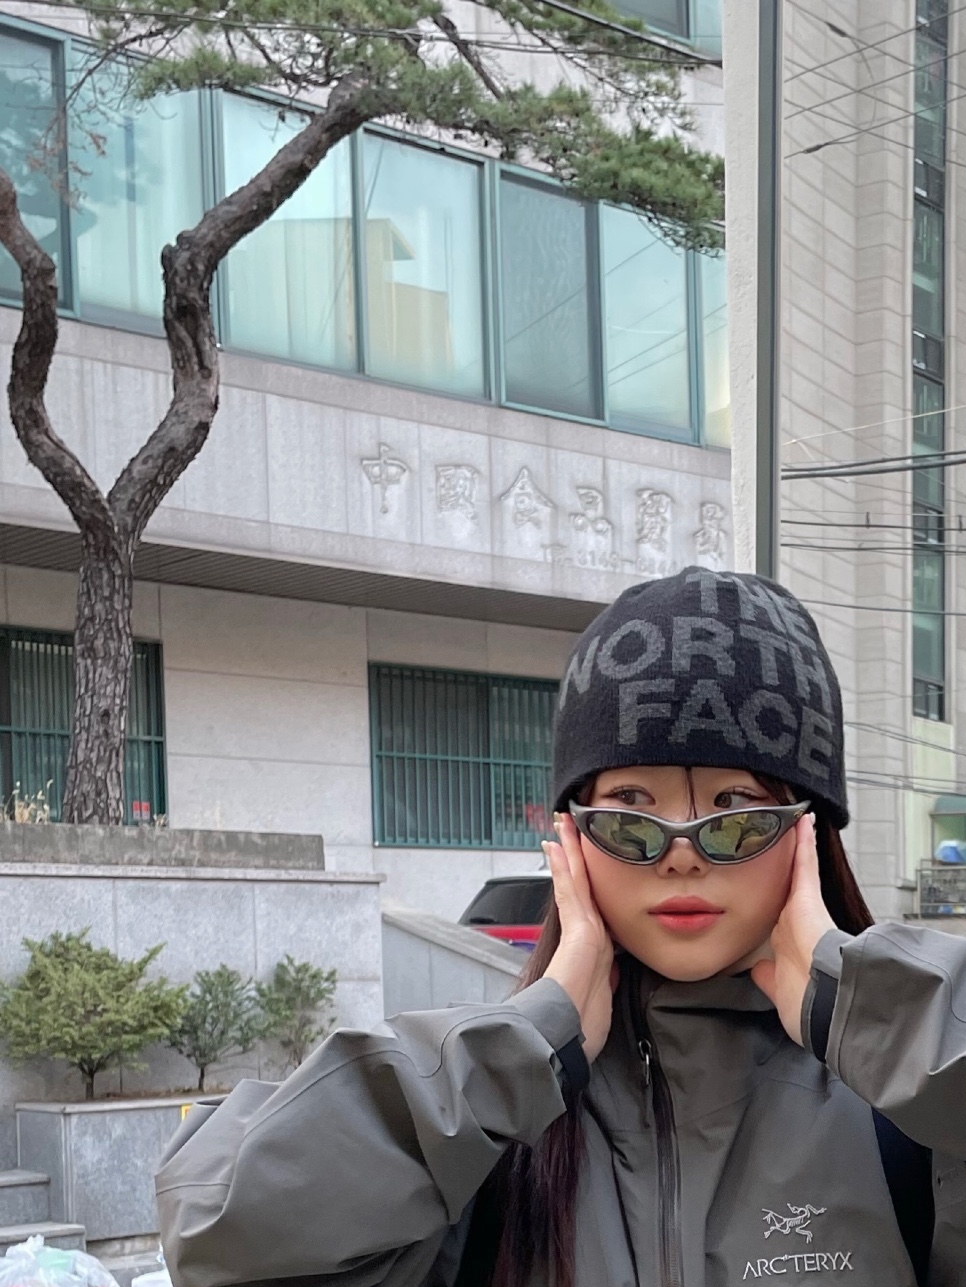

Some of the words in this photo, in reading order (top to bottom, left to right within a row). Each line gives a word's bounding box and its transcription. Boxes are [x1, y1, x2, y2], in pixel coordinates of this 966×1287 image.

[684, 572, 819, 654] THE
[559, 615, 834, 715] NORTH
[617, 678, 834, 779] FACE
